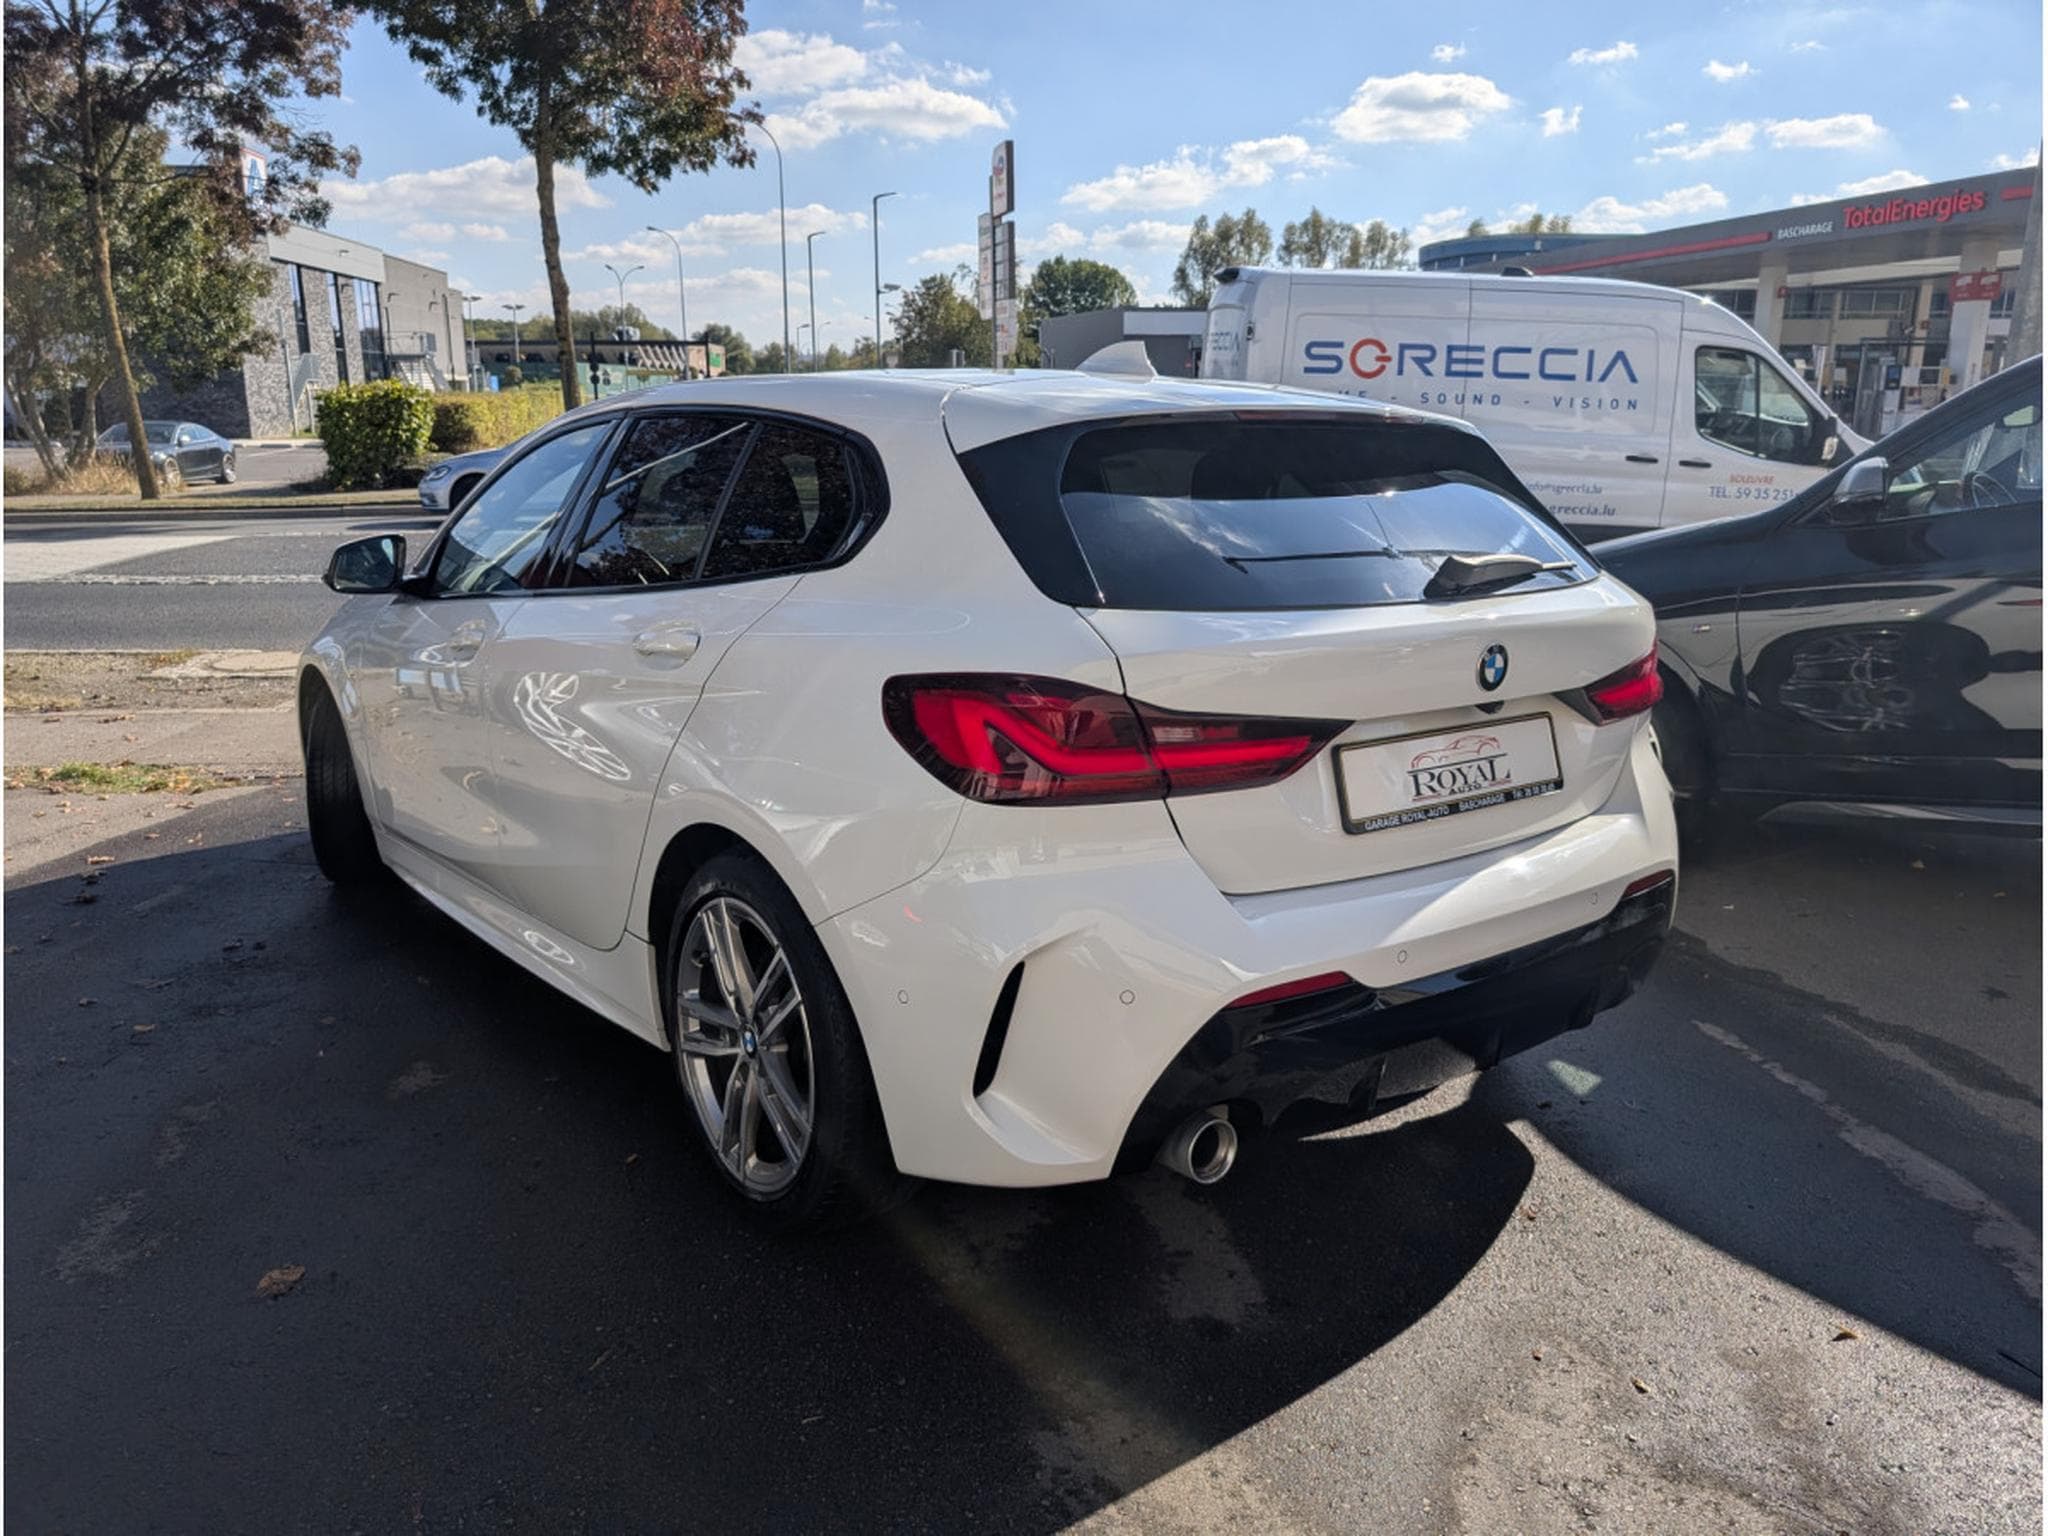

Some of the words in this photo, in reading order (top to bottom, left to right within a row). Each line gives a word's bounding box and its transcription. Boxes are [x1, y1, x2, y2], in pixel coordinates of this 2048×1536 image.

[1843, 188, 1985, 229] TotalEnergies
[1777, 221, 1834, 240] BASCHARAGE
[1420, 392, 1502, 406] SOUND
[1552, 396, 1637, 410] VISION
[1412, 757, 1511, 797] ROYAL
[1450, 783, 1482, 795] AUTO
[1365, 814, 1400, 831] GARAGE
[1401, 809, 1427, 825] ROYAL
[1427, 804, 1450, 819] AUTO
[1458, 793, 1506, 812] BASCHARAGE
